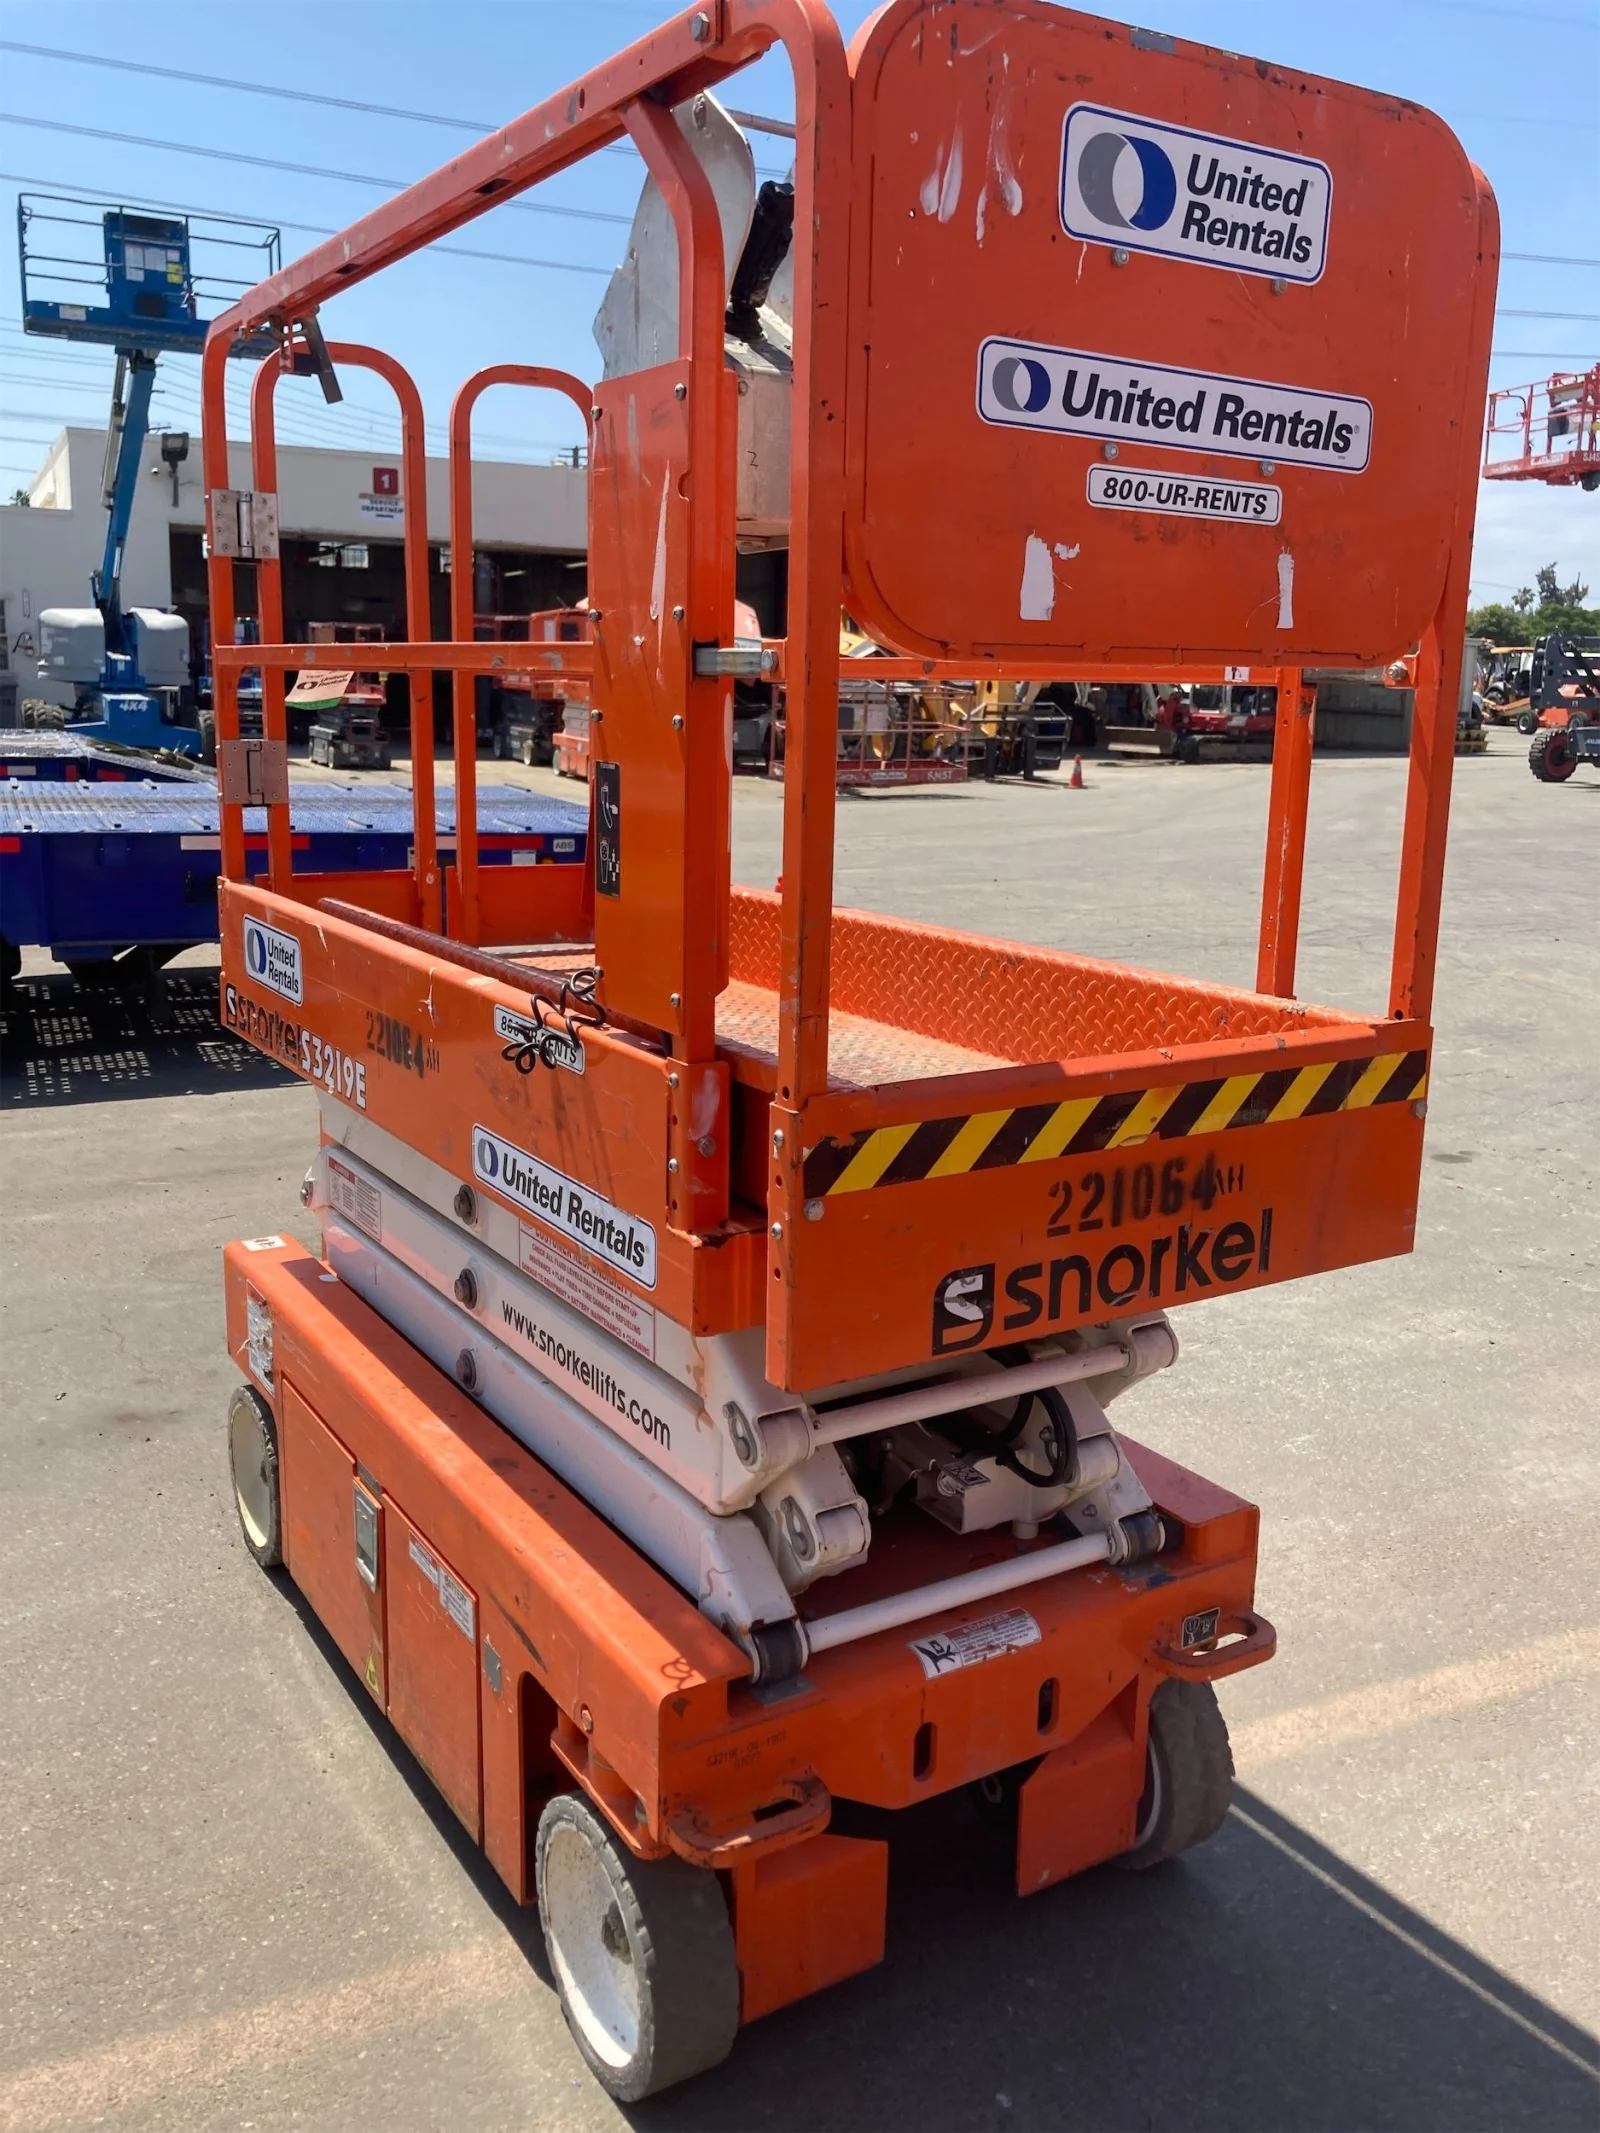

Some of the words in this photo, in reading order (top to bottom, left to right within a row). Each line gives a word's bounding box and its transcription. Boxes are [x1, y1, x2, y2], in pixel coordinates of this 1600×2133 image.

[1186, 153, 1309, 217] United
[1180, 200, 1312, 264] Rentals
[1062, 370, 1206, 433] United
[1212, 393, 1354, 453] Rentals
[361, 505, 404, 513] DEPARTMEN
[381, 473, 391, 490] 1
[1103, 477, 1268, 515] 800-UR-RENTS
[555, 841, 574, 850] ABS
[267, 936, 296, 969] United
[268, 960, 299, 995] Rentals
[302, 1029, 367, 1111] S3219E
[502, 1153, 563, 1217] United
[567, 1191, 645, 1268] Rentals
[597, 1285, 613, 1303] BEFORE
[1003, 1207, 1273, 1331] snorkel
[571, 1295, 589, 1314] BATTERY
[626, 1333, 649, 1356] CLEANING
[502, 1300, 671, 1450] www.snorkellifts.com
